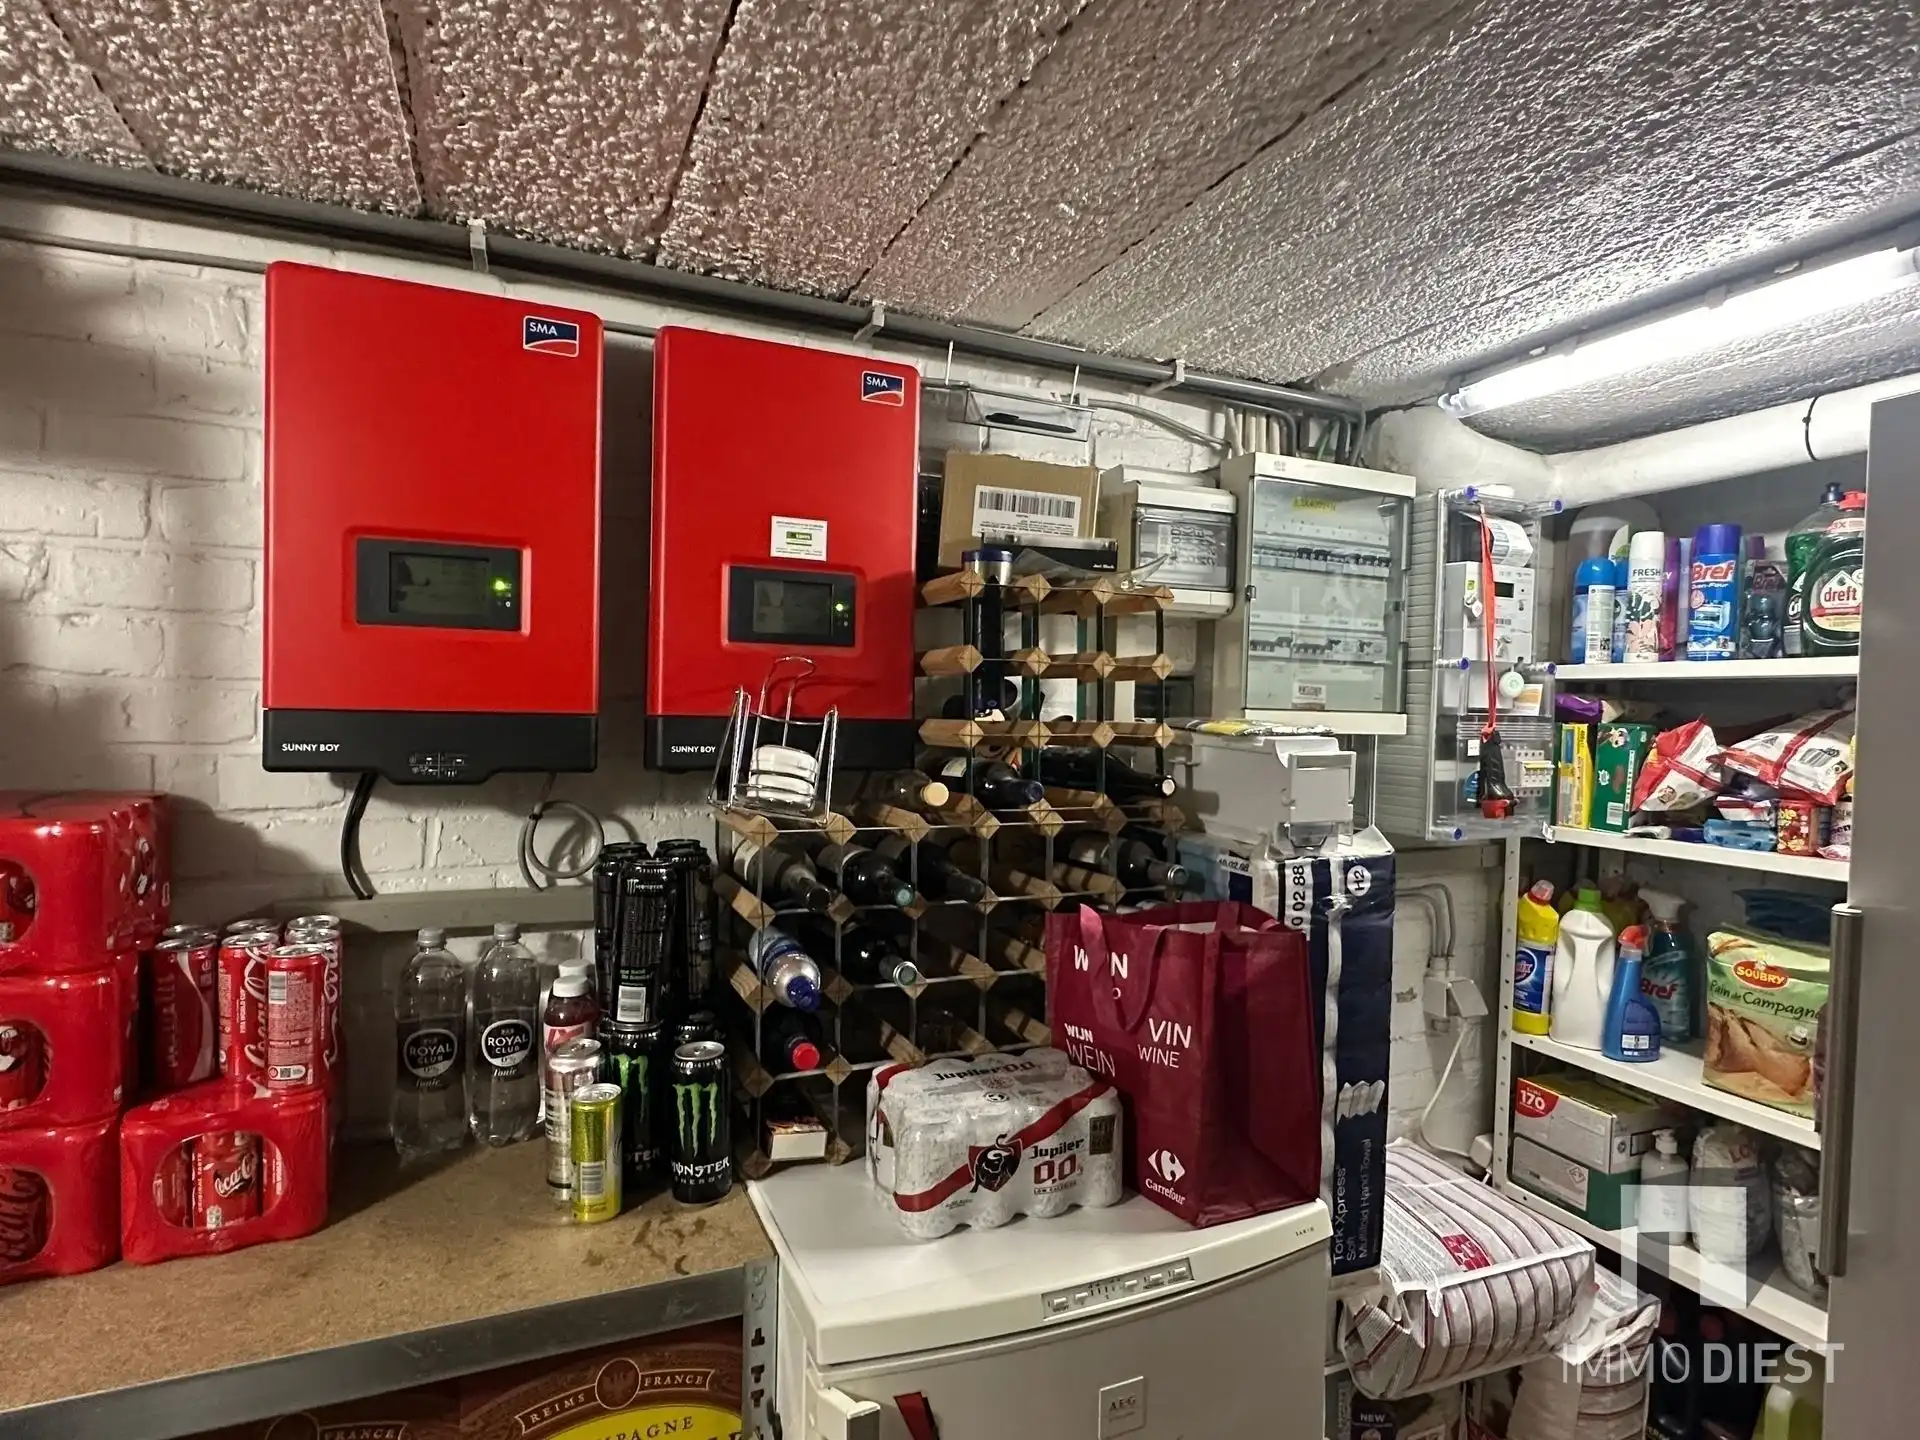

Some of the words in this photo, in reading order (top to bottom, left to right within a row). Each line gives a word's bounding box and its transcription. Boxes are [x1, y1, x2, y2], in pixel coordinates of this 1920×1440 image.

[529, 321, 558, 336] SMA
[866, 376, 888, 388] SMA
[1632, 568, 1662, 577] FRESH
[1691, 562, 1736, 581] Bref
[1824, 587, 1858, 602] dreft
[281, 743, 318, 752] SUNNY
[319, 743, 340, 752] BOY
[670, 745, 700, 753] SUNNY
[700, 745, 716, 753] BOY
[1293, 864, 1305, 887] 88
[1353, 869, 1365, 892] H2
[1736, 966, 1785, 985] SOUBRY
[1641, 978, 1678, 999] Bref
[487, 1033, 529, 1047] ROYAL
[1064, 1022, 1094, 1044] WIJN
[1149, 1017, 1192, 1049] VIN
[409, 1042, 453, 1057] ROYAL
[495, 1045, 520, 1054] CLUB
[1066, 1038, 1116, 1078] WEIN
[1138, 1043, 1180, 1069] WINE
[417, 1055, 443, 1065] CLUB
[932, 1065, 1000, 1081] Jupiler
[1519, 1089, 1546, 1110] 170
[1030, 1137, 1085, 1160] Jupiler
[1361, 1138, 1373, 1177] Towel
[1145, 1178, 1186, 1206] Carrefour
[1360, 1180, 1371, 1204] Hand
[1334, 1228, 1344, 1265] Tork
[530, 1392, 585, 1424] REIMS
[643, 1374, 704, 1387] FRANCE
[1359, 1412, 1386, 1424] NEW
